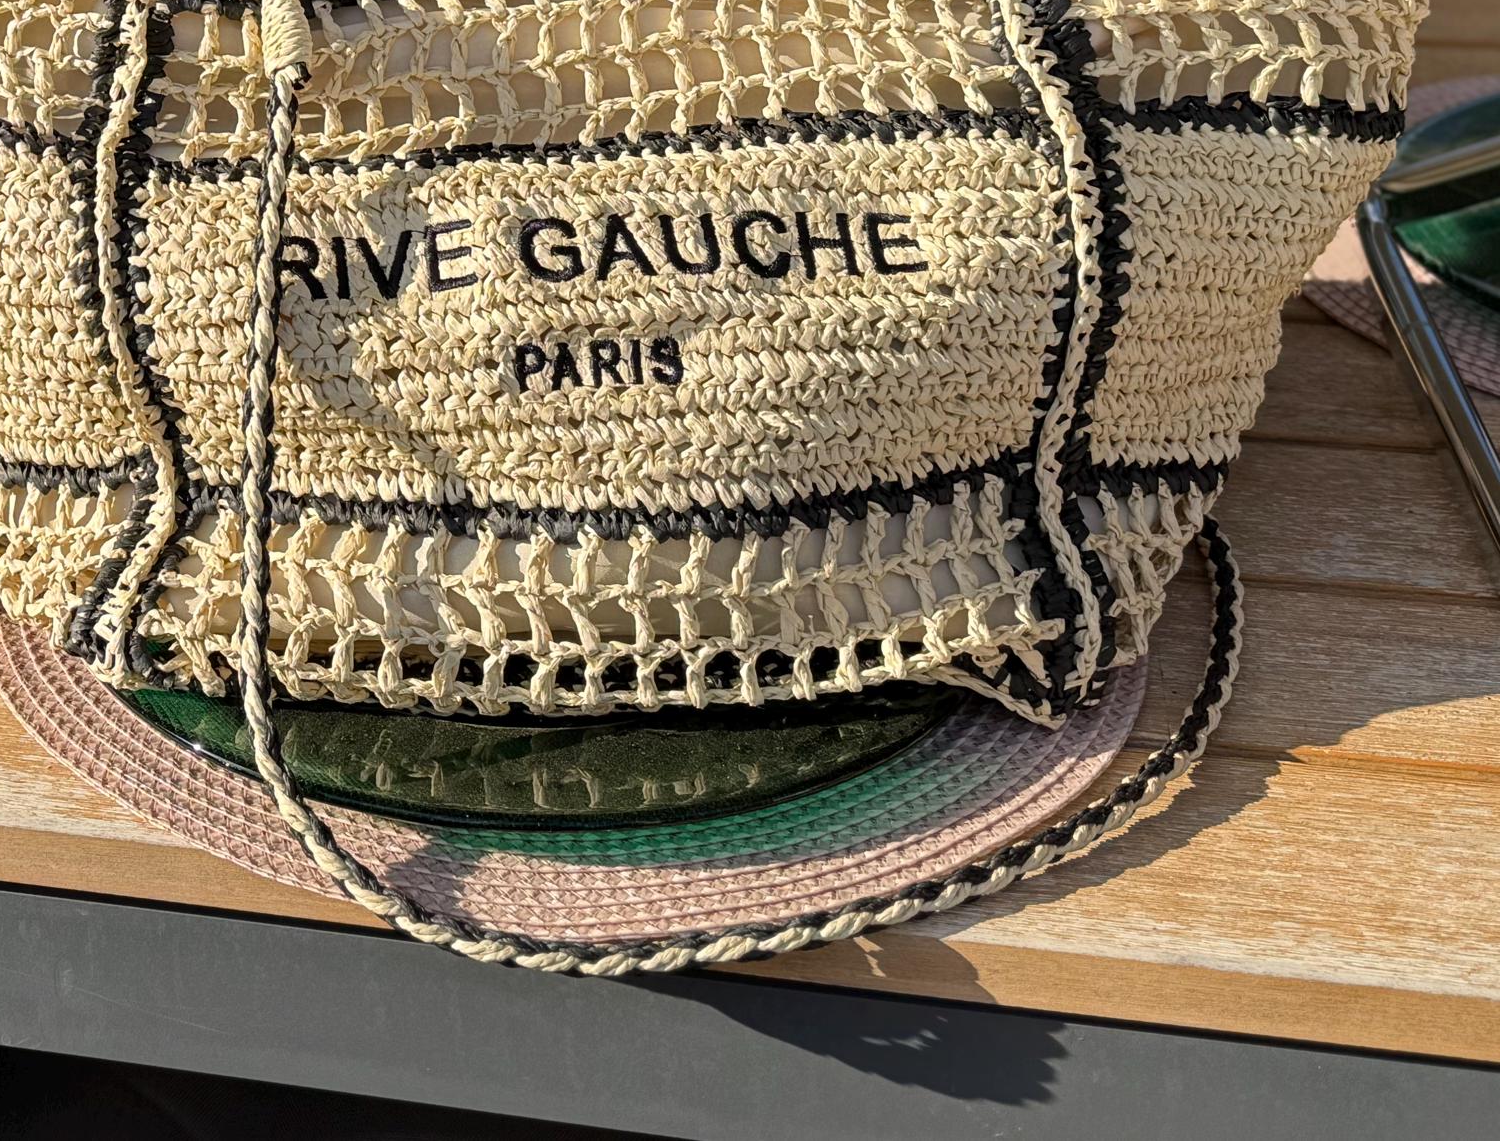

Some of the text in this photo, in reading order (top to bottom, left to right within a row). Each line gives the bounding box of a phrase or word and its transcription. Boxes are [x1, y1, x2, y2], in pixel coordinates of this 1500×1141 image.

[273, 210, 929, 301] RIVE GAUCHE
[515, 335, 683, 391] PARIS
